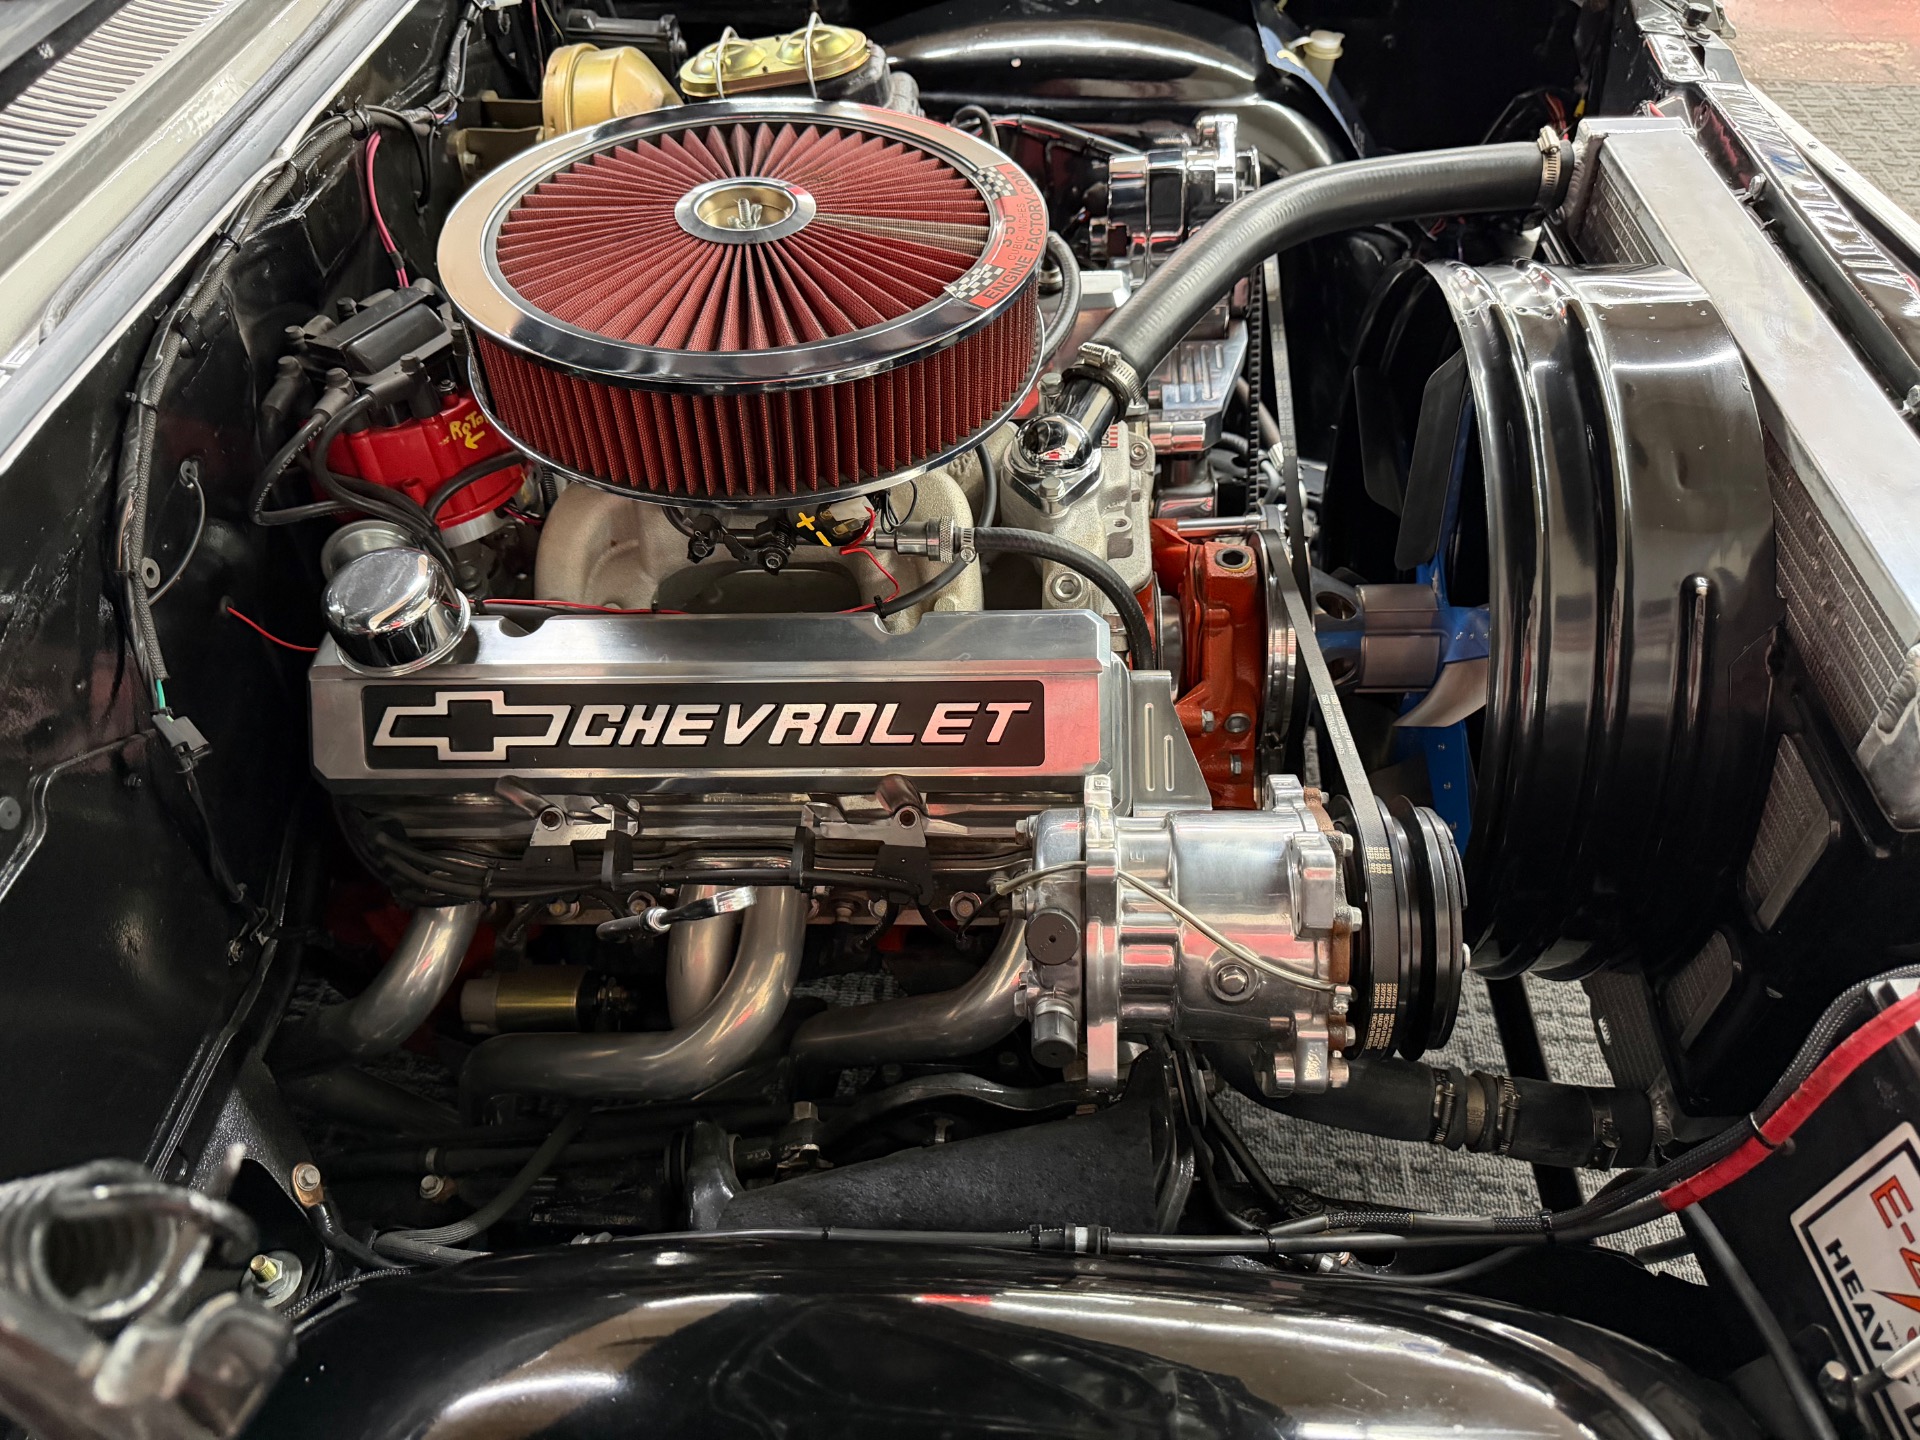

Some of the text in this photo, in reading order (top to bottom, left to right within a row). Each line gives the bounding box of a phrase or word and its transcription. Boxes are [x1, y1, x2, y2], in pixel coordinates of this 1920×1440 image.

[982, 169, 1044, 300] ENGINE FACTORY.COM
[1000, 213, 1017, 248] 350
[1007, 203, 1028, 261] CUBIC INCHES
[276, 453, 296, 475] MADE
[297, 443, 305, 452] IN
[568, 701, 1032, 746] CHEVROLET
[1825, 1238, 1911, 1384] HEAV
